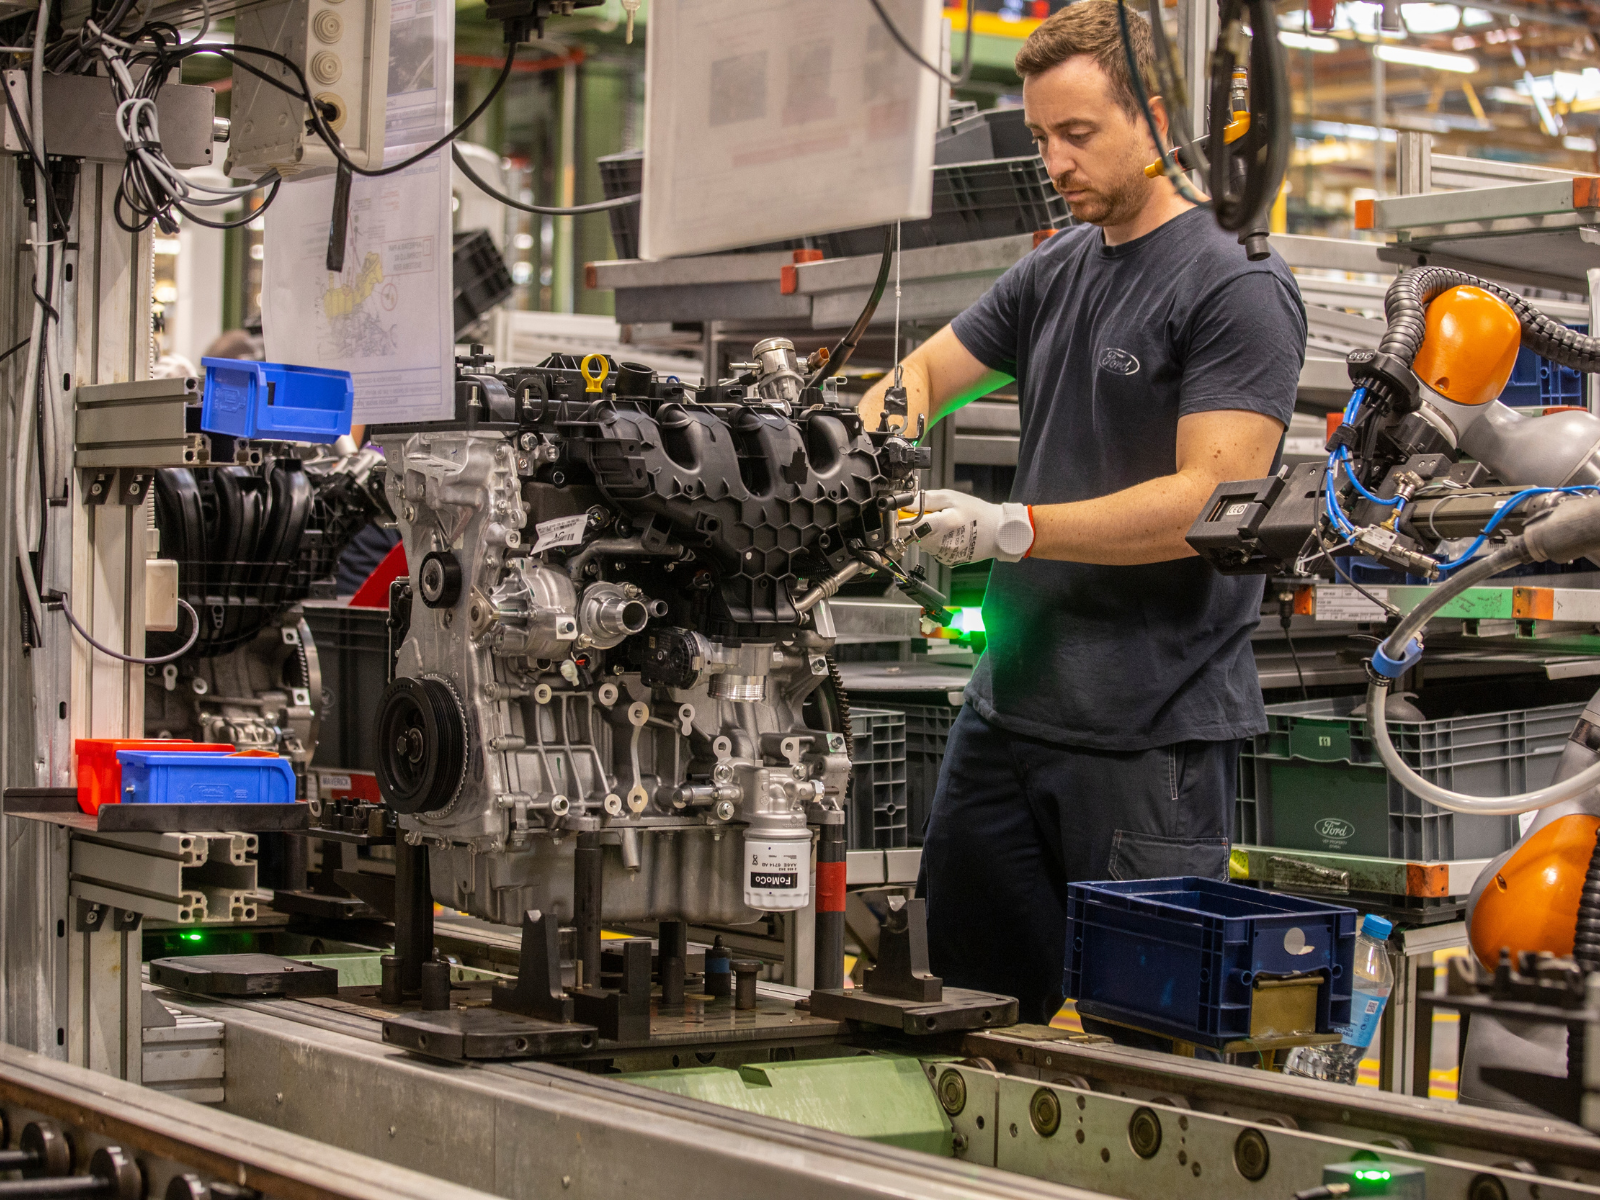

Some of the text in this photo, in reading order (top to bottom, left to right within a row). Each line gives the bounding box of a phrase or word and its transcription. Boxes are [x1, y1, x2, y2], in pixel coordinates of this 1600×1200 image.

[1101, 350, 1133, 372] Ford
[1320, 820, 1350, 837] Ford
[755, 876, 791, 885] FoMoCo
